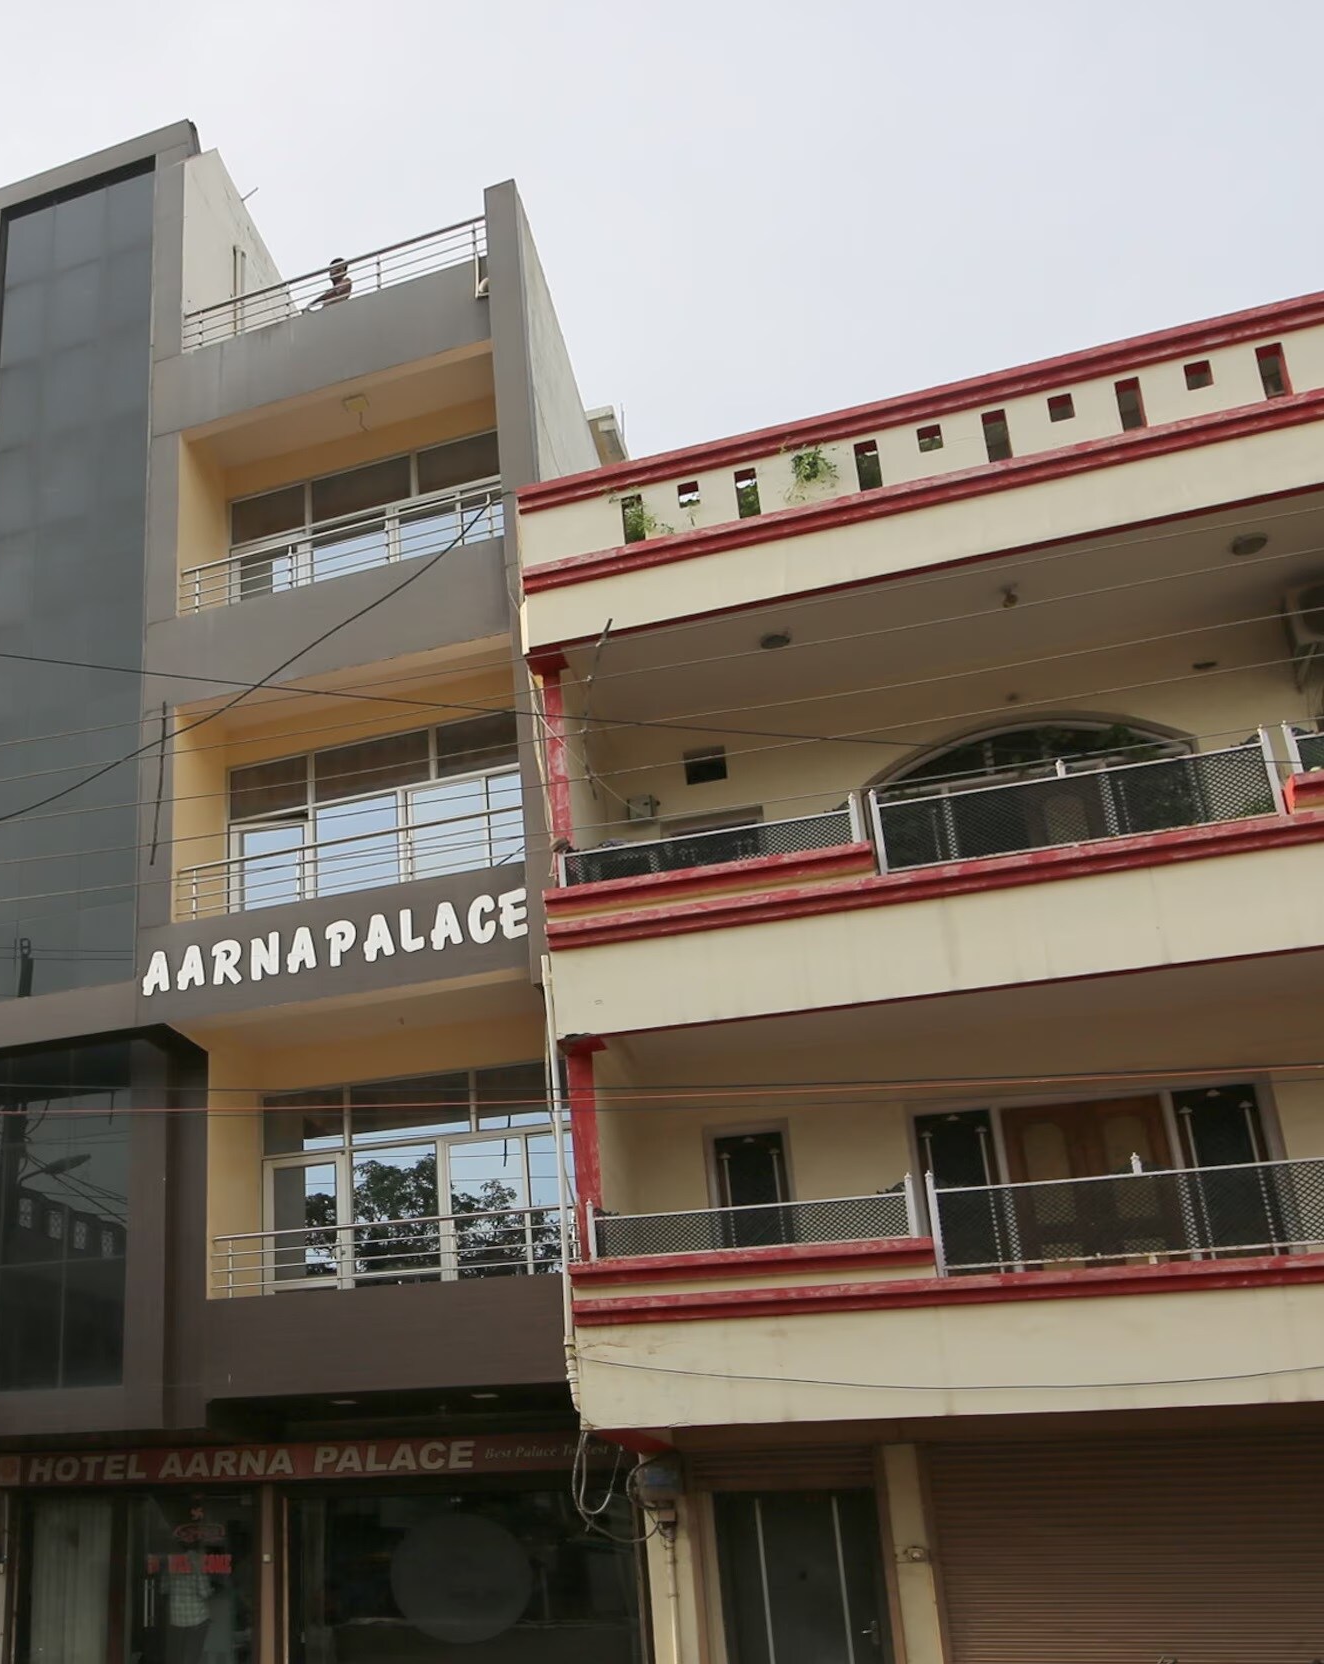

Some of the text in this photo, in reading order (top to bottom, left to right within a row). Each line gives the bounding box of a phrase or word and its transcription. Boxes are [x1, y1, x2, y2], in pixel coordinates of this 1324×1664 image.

[28, 1441, 475, 1482] HOTEL AARNA PALACE
[484, 1447, 512, 1459] Best
